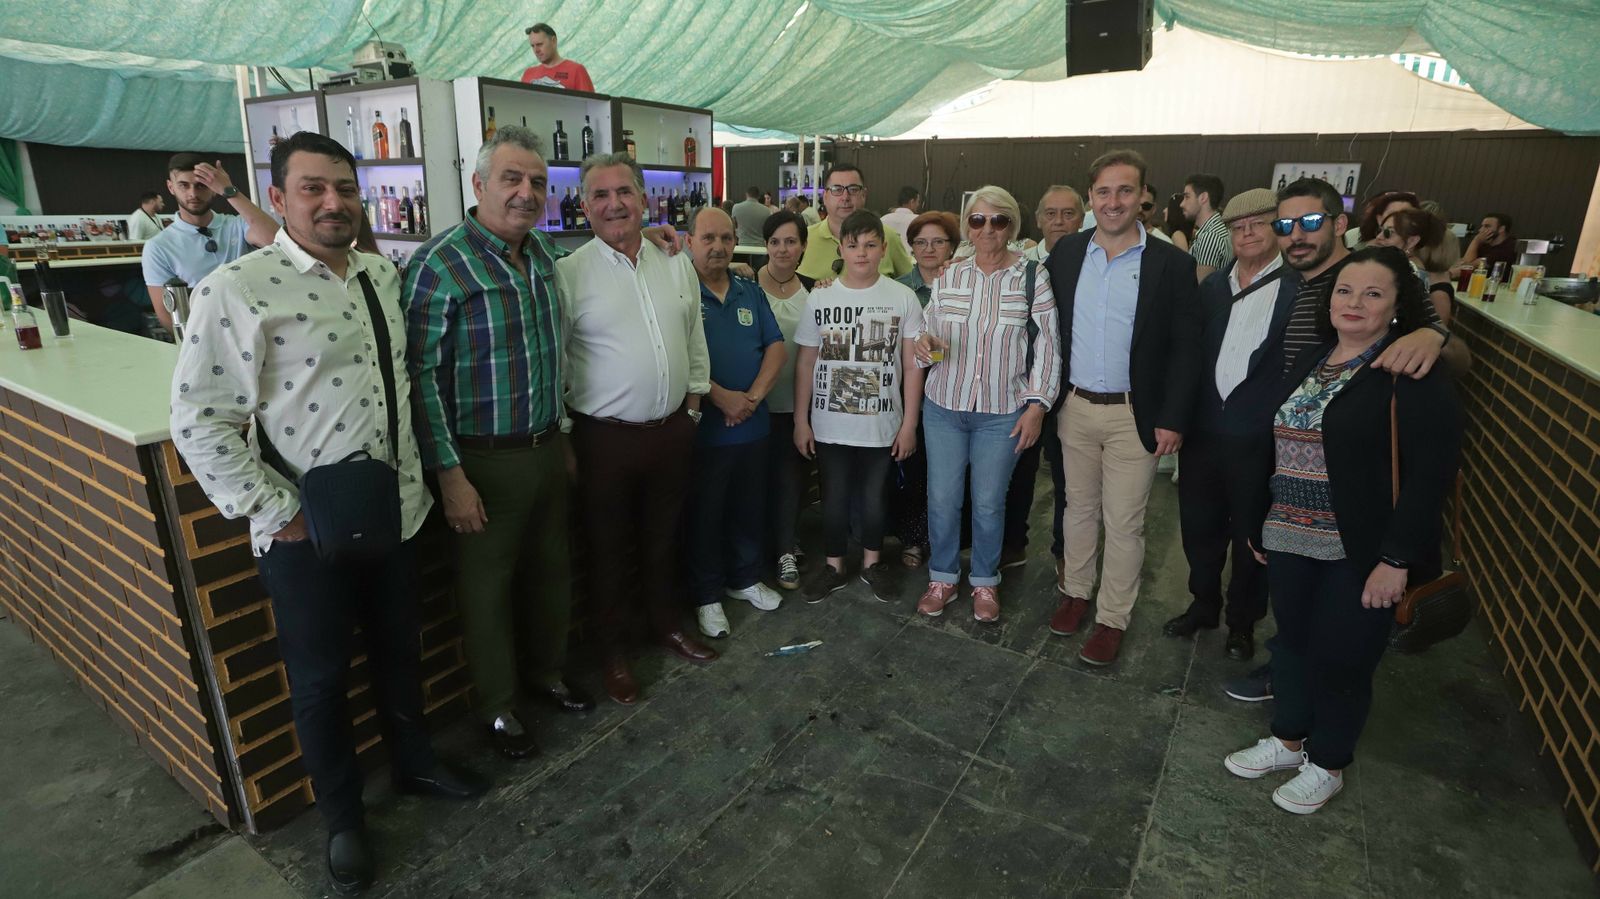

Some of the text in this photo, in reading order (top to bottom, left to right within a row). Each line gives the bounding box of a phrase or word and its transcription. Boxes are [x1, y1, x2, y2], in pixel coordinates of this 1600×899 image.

[815, 306, 864, 326] BROOK
[829, 327, 860, 345] LYN
[815, 397, 825, 410] 89
